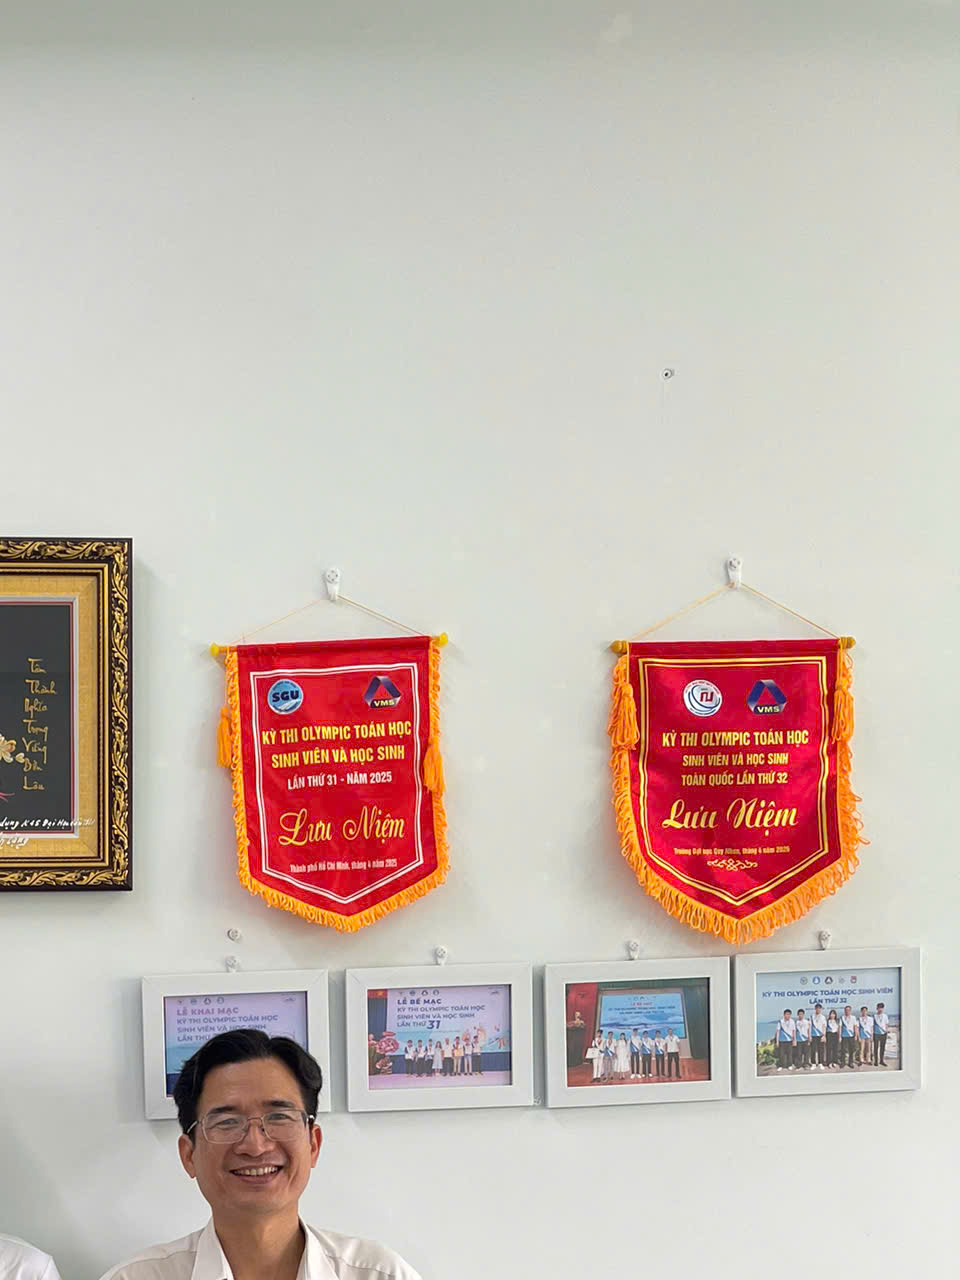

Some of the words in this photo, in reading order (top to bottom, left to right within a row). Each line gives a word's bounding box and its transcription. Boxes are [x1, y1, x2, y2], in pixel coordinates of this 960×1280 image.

[25, 680, 57, 694] Thành
[272, 690, 300, 703] SGU
[262, 728, 276, 744] KỲ
[280, 728, 298, 744] THI
[302, 726, 351, 741] OLYMPIC
[354, 721, 386, 739] TOÁN
[388, 721, 411, 738] HỌC
[662, 730, 677, 747] KỲ
[680, 732, 698, 746] THI
[702, 732, 751, 746] OLYMPIC
[753, 728, 784, 745] TOÁN
[786, 730, 809, 748] HỌC
[272, 752, 300, 768] SINH
[302, 746, 329, 765] VIÊN
[332, 746, 348, 763] VÀ
[350, 748, 374, 766] HỌC
[378, 745, 405, 761] SINH
[682, 754, 705, 766] SINH
[708, 752, 729, 766] VIÊN
[732, 752, 744, 766] VÀ
[746, 753, 765, 768] HỌC
[768, 752, 789, 765] SINH
[23, 776, 45, 790] Lâu
[307, 772, 326, 787] THỨ
[327, 774, 337, 786] 31
[346, 771, 368, 784] NĂM
[370, 771, 392, 784] 2025
[681, 772, 706, 786] TOÀN
[708, 770, 734, 787] QUỐC
[758, 770, 776, 785] THỨ
[776, 772, 788, 784] 32
[0, 816, 19, 830] dụng
[662, 799, 718, 829] Lưu
[727, 798, 799, 837] Niệm
[278, 808, 332, 846] Lưu
[342, 806, 405, 844] Niệm
[191, 1008, 215, 1016] KHAI
[218, 1008, 239, 1016] MẠC
[202, 1016, 237, 1024] OLYMPIC
[427, 1020, 441, 1029] 31
